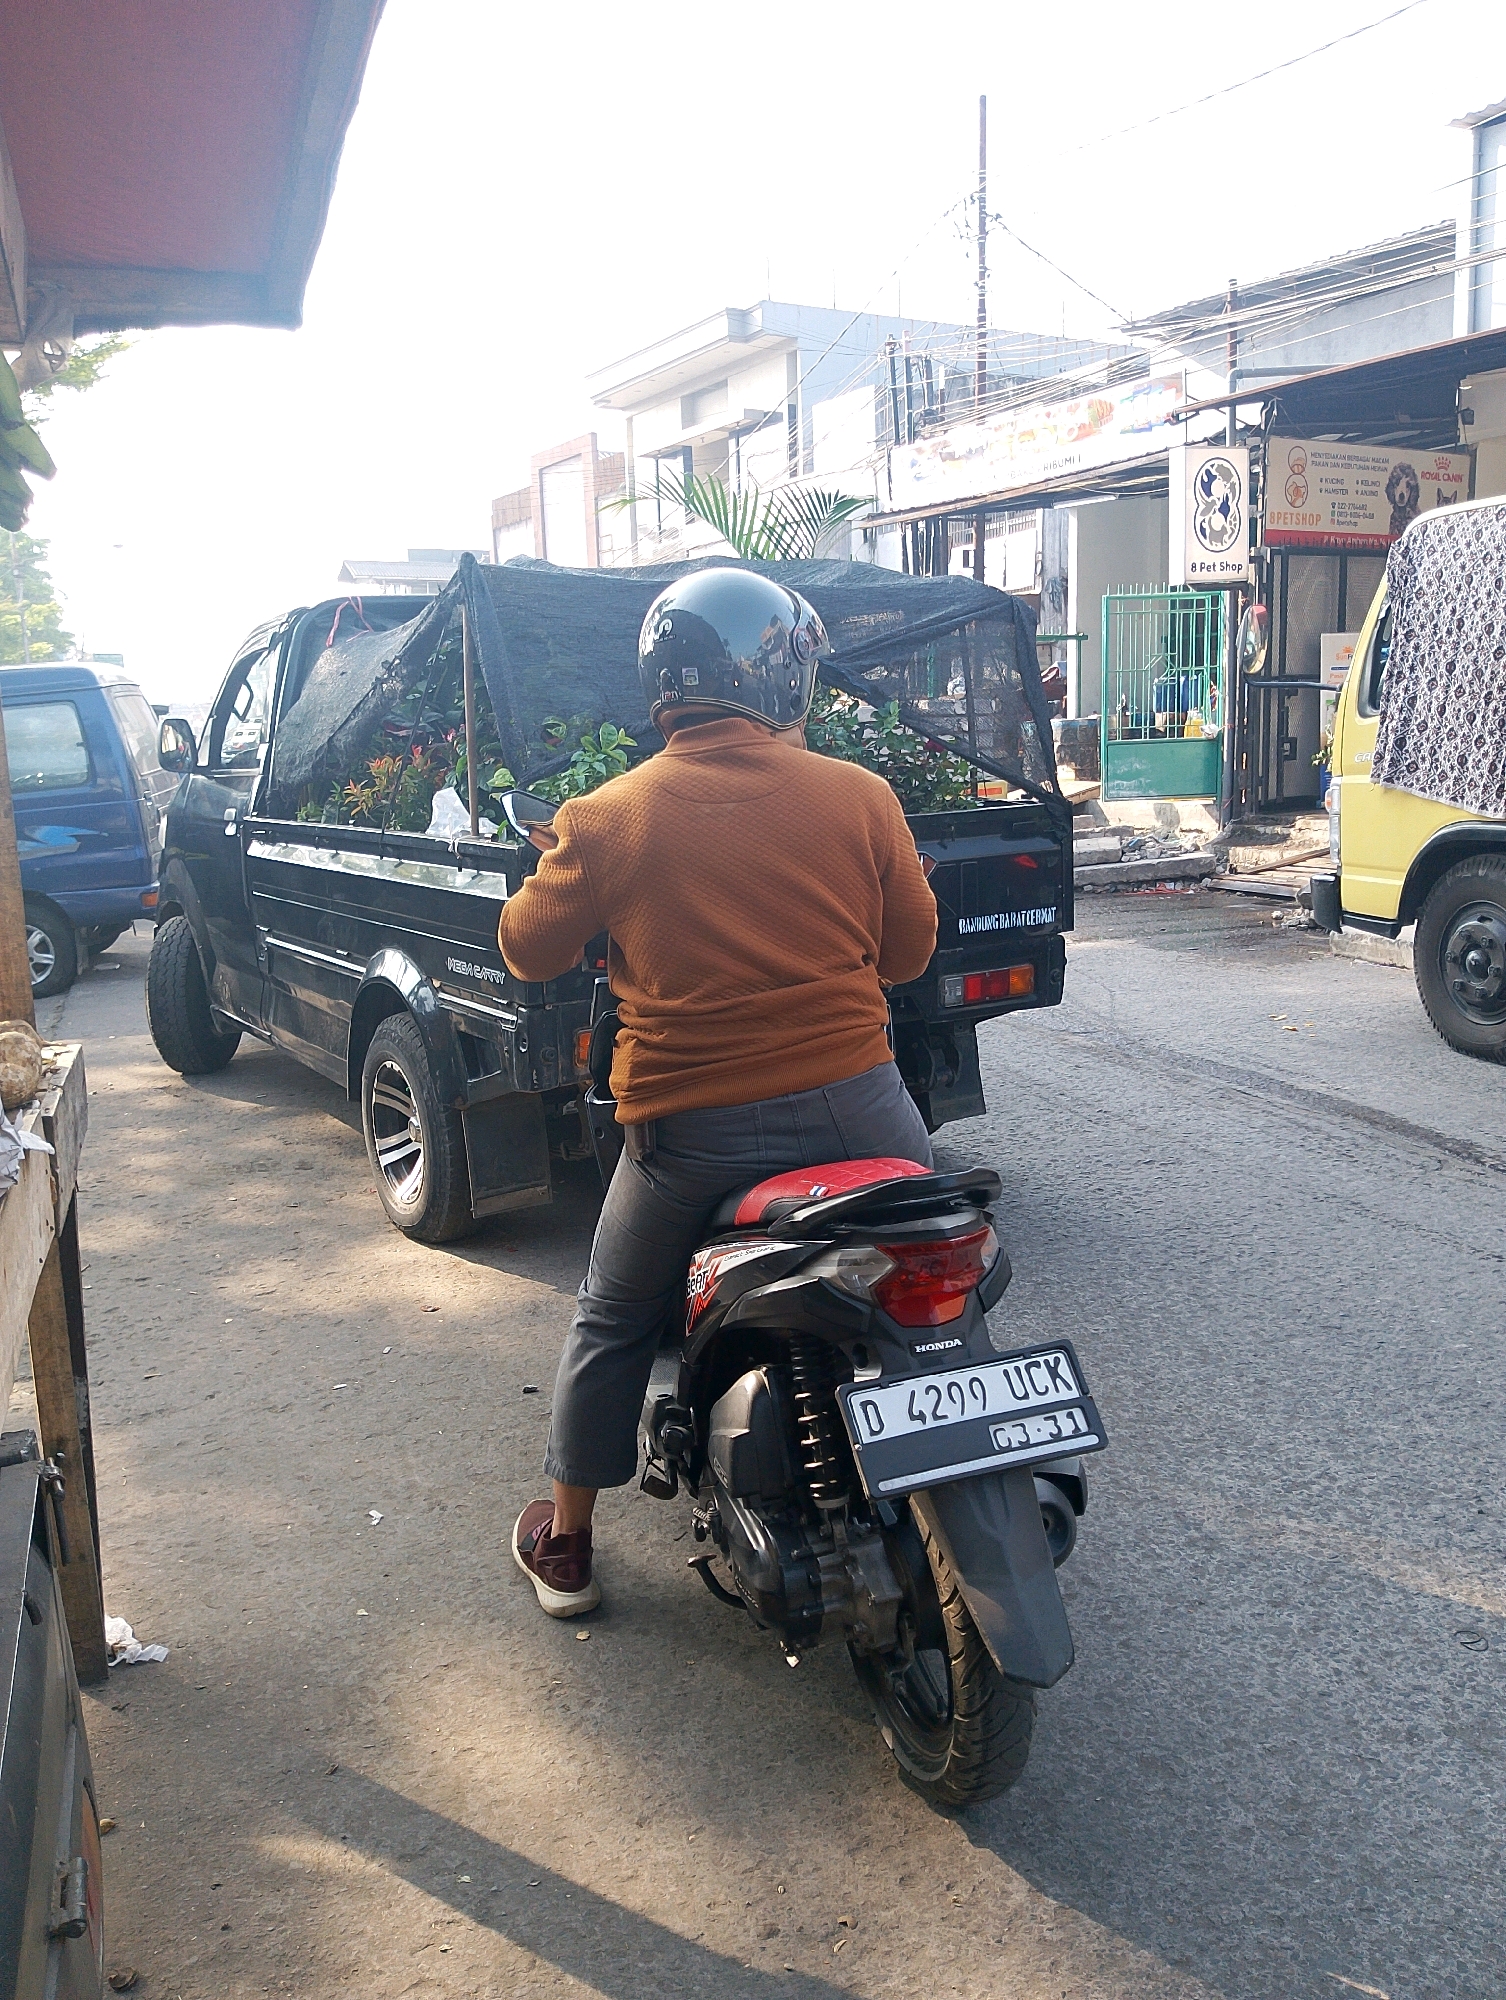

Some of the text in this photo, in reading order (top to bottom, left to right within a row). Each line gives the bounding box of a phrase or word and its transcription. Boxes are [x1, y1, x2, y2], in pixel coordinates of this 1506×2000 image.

[1421, 471, 1463, 482] ROYAL CANIN
[1269, 511, 1322, 526] 8PETSHOP
[1190, 561, 1243, 574] 8 Pet Shop
[959, 914, 999, 935] BANDUNG
[999, 911, 1026, 929] BARAT
[447, 956, 506, 985] MEGA CARRY
[914, 1337, 962, 1353] HONDA
[859, 1355, 1073, 1437] D 4299 UCK
